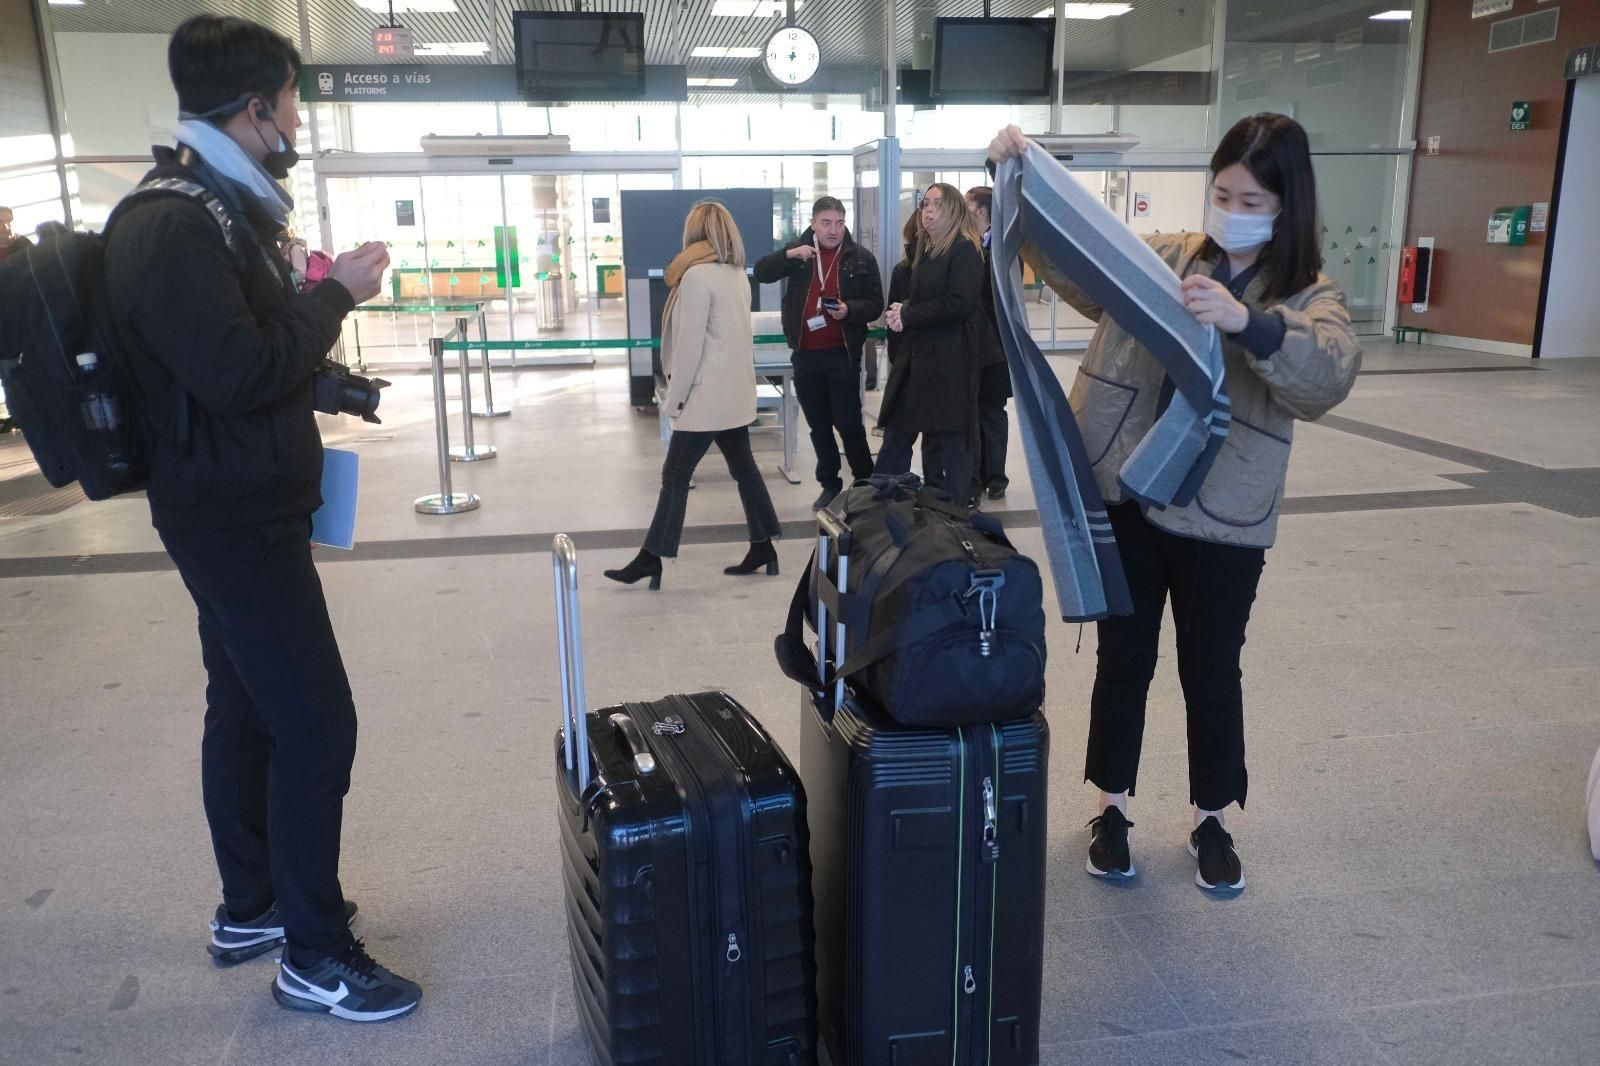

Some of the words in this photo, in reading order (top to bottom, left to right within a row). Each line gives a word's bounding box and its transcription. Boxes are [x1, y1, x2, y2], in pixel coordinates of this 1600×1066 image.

[788, 33, 798, 41] 12
[770, 53, 777, 61] 9
[808, 53, 815, 61] 3
[344, 72, 388, 84] Acceso
[392, 74, 400, 84] a
[405, 71, 431, 84] vías
[344, 87, 387, 96] PLATFORMS
